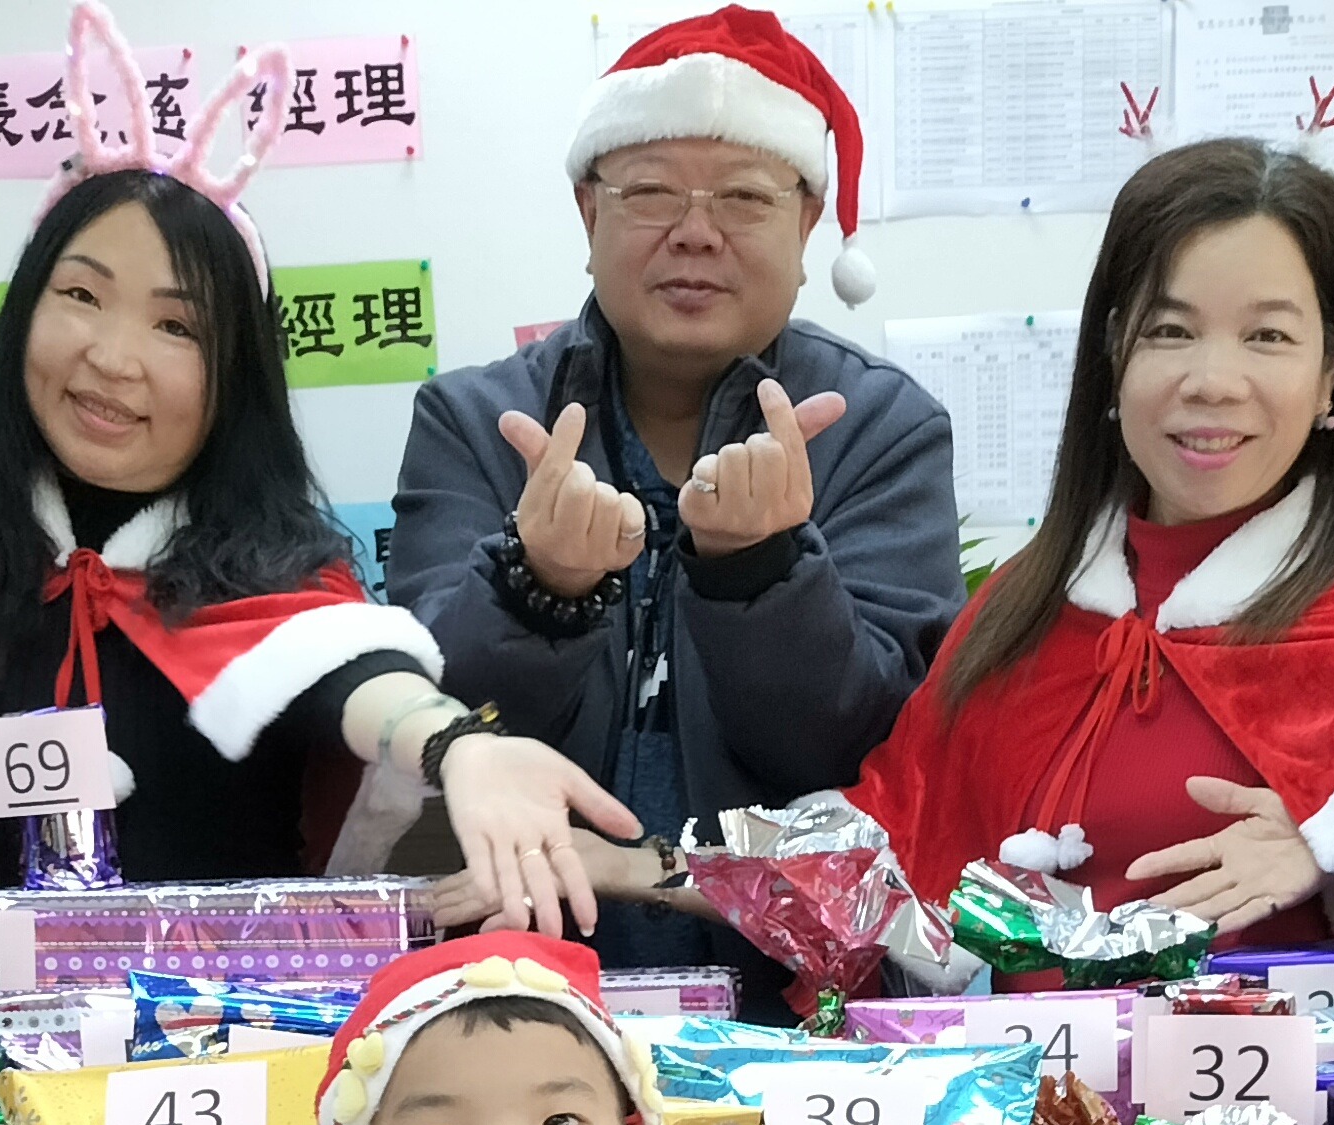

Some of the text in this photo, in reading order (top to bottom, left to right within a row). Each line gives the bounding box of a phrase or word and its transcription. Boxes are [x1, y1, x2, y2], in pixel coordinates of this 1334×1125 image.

[247, 62, 416, 135] 經理
[276, 286, 432, 360] 經理
[4, 738, 71, 796] 69
[1188, 1044, 1270, 1103] 32
